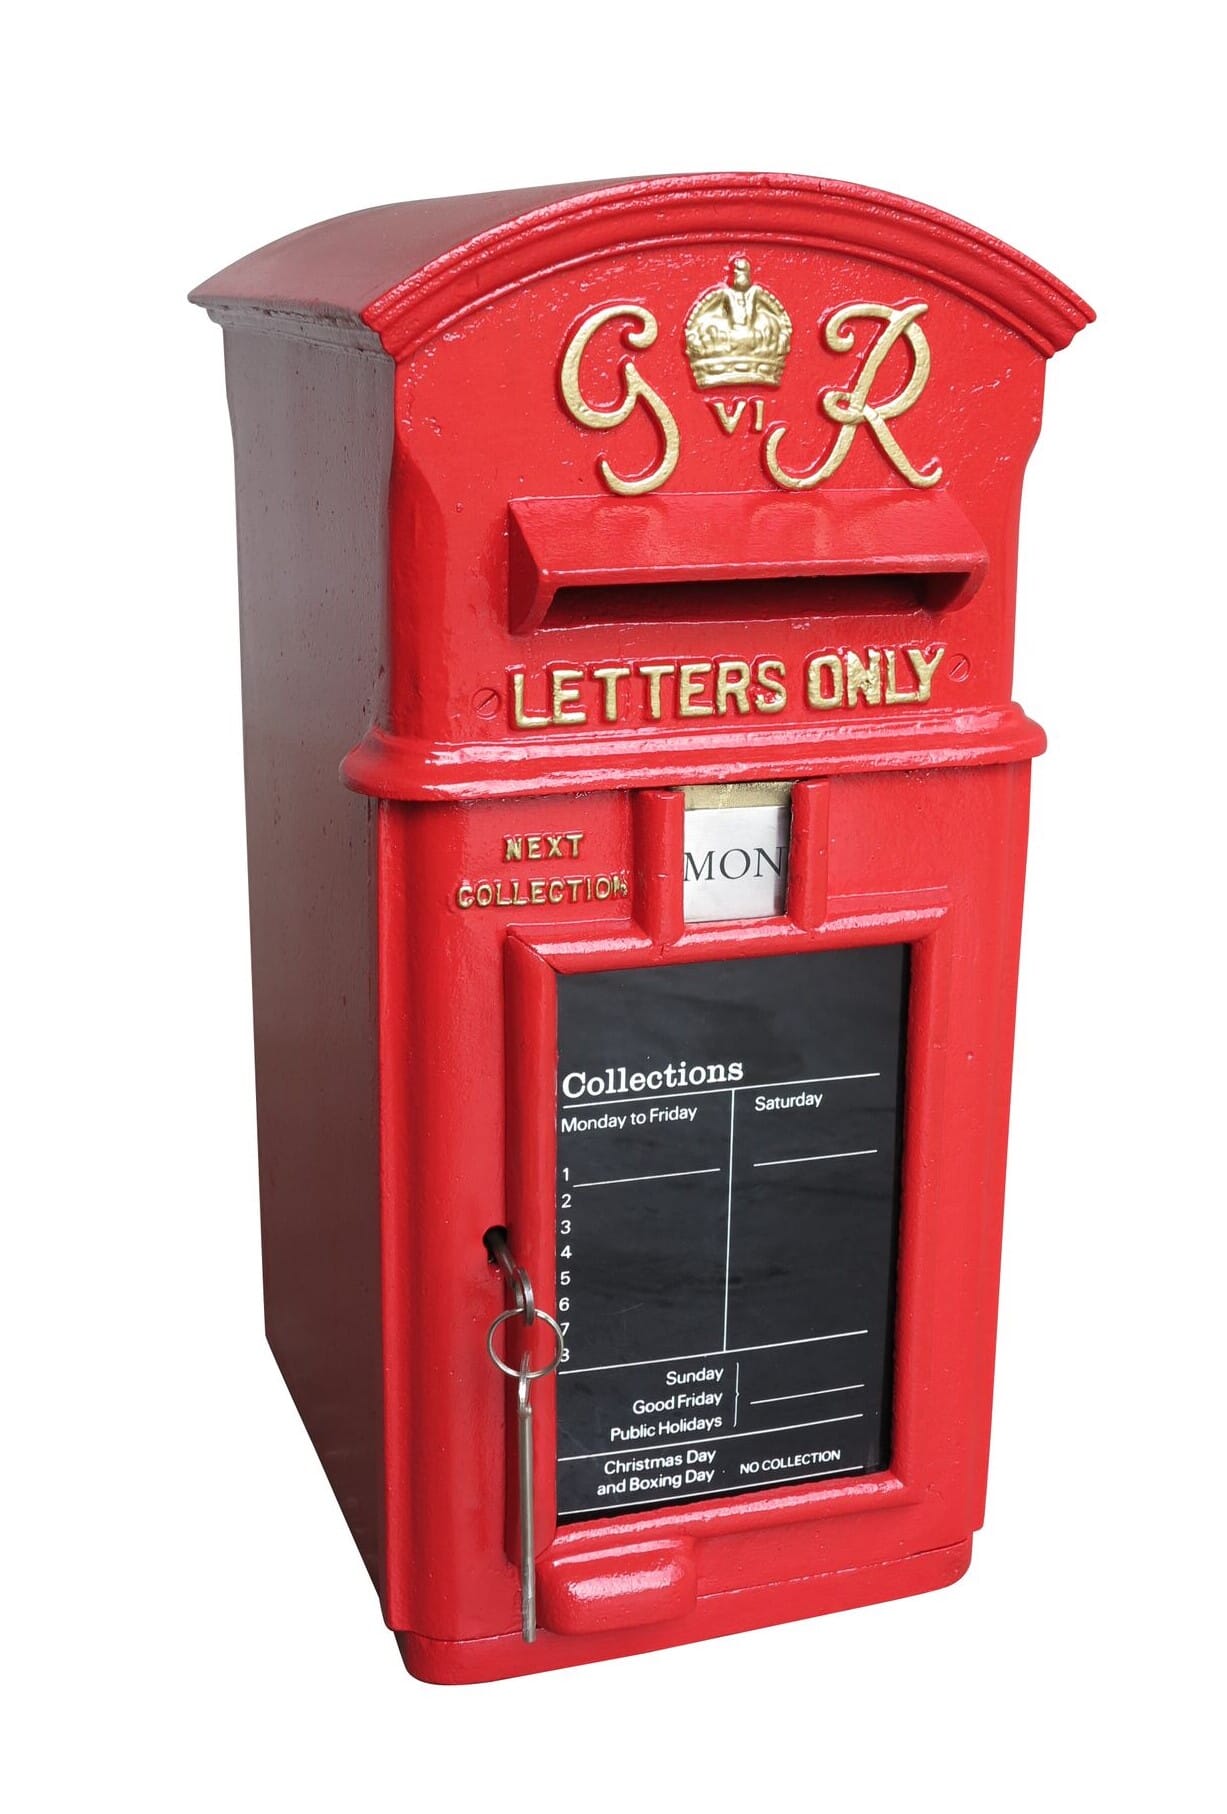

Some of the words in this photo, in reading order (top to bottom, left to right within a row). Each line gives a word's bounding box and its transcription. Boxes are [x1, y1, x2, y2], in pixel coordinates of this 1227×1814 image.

[560, 304, 680, 496] G
[766, 303, 943, 491] R
[713, 400, 764, 434] VI
[515, 660, 787, 728] LETTERS
[808, 648, 945, 710] ONLY
[505, 832, 584, 861] NEXT
[684, 846, 786, 881] MON
[562, 1061, 743, 1098] Collections
[755, 1092, 822, 1111] Saturday
[561, 1113, 627, 1133] Monday
[631, 1113, 646, 1125] to
[650, 1105, 697, 1123] Friday
[562, 1168, 569, 1181] 1
[561, 1194, 571, 1208] 2
[561, 1220, 571, 1234] 3
[561, 1245, 571, 1258] 4
[560, 1272, 570, 1285] 5
[559, 1298, 569, 1311] 6
[560, 1323, 569, 1337] 7
[666, 1368, 723, 1386] Sunday
[633, 1396, 674, 1414] Good
[678, 1392, 722, 1409] Friday
[610, 1424, 655, 1442] Public
[659, 1415, 722, 1435] Holidays
[604, 1453, 683, 1475] Christmas
[687, 1449, 716, 1464] Day
[740, 1462, 759, 1474] NO
[762, 1450, 841, 1472] COLLECTION
[597, 1480, 626, 1495] and
[629, 1473, 682, 1491] Boxing
[685, 1469, 715, 1484] Day
